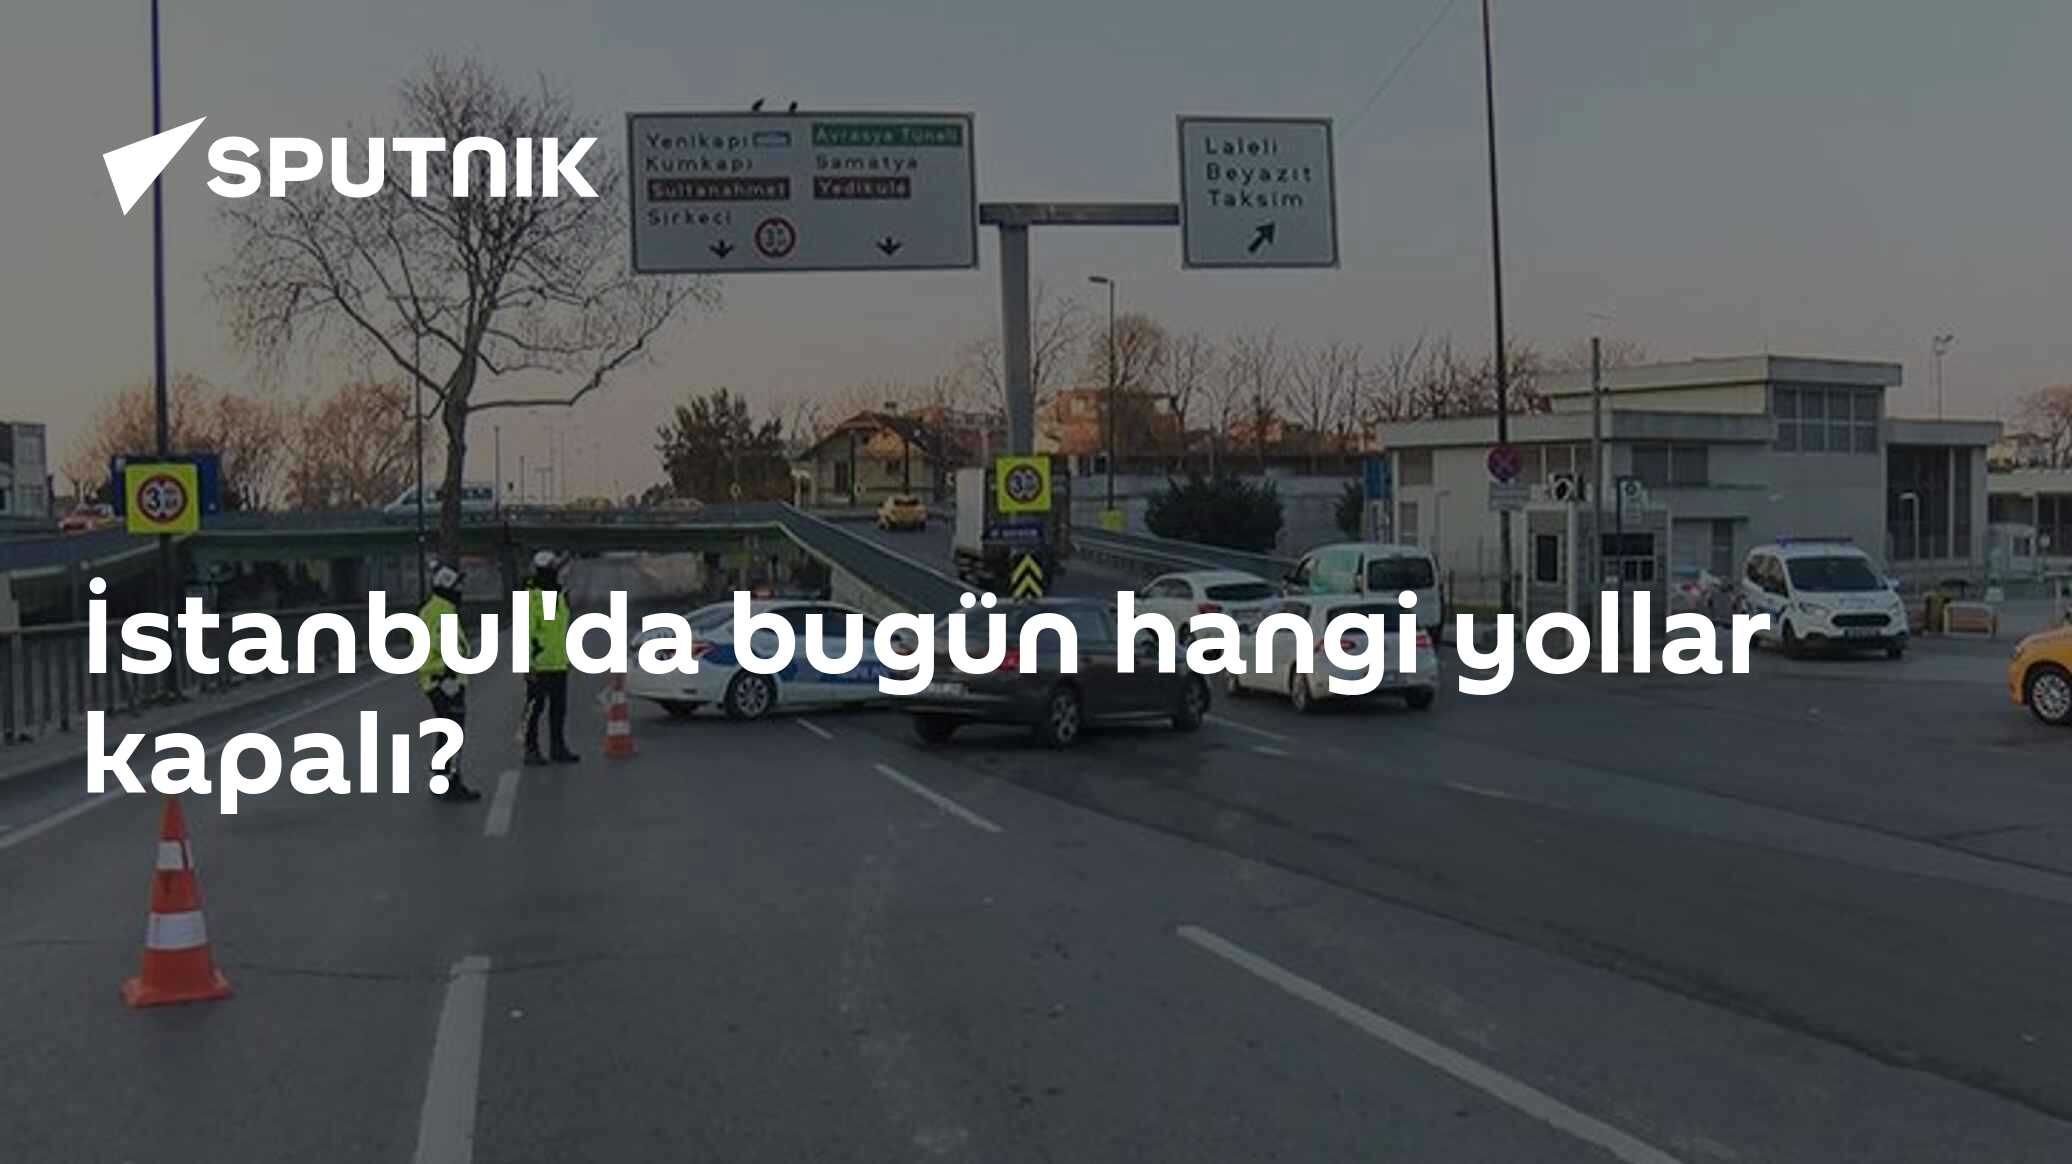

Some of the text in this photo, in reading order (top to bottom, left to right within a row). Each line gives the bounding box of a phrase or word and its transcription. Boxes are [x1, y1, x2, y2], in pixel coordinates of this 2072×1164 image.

[816, 126, 895, 145] Avrasya
[1205, 136, 1278, 155] Laleli
[816, 155, 918, 171] Samatya
[650, 181, 787, 199] Sultanahmet
[817, 180, 907, 197] Yedikule
[1208, 188, 1303, 207] Taksim
[647, 209, 732, 227] Sirkeci
